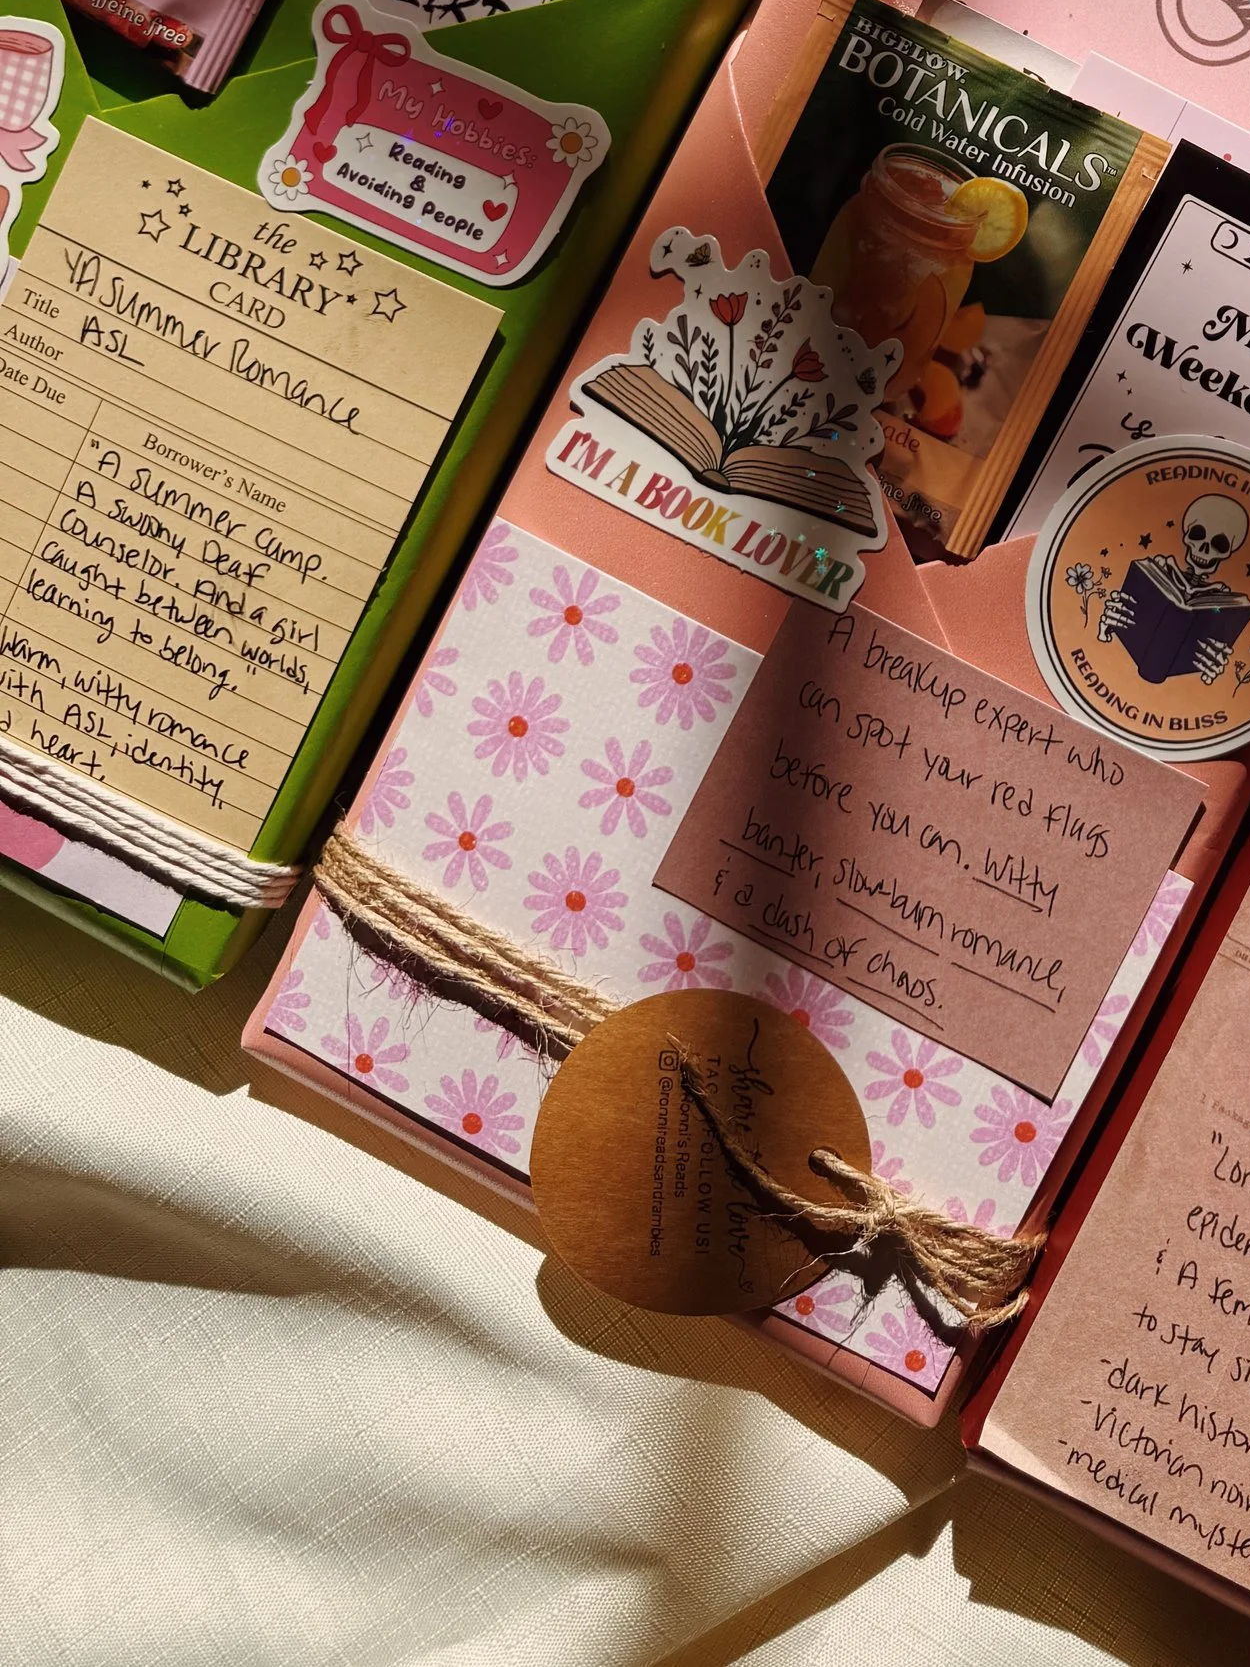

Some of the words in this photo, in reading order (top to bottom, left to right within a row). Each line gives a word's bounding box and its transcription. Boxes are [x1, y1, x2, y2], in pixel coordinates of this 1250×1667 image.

[144, 15, 188, 47] free
[377, 80, 423, 119] My
[432, 105, 538, 169] Hobbies:
[388, 142, 467, 190] Reading
[877, 96, 924, 130] Cold
[931, 118, 990, 162] Water
[992, 153, 1076, 208] Infusion
[336, 162, 416, 209] Avoiding
[421, 201, 484, 241] People
[409, 175, 425, 193] &
[253, 220, 298, 255] the
[64, 248, 100, 296] YA
[179, 224, 340, 317] LIBRARY
[21, 287, 61, 319] Title
[208, 281, 287, 332] CARD
[3, 324, 64, 361] Author
[80, 316, 145, 367] ASL
[31, 376, 66, 404] Due
[142, 432, 235, 489] Borrower's
[236, 477, 287, 514] Name
[1145, 465, 1239, 487] READING
[75, 481, 96, 509] A
[202, 540, 271, 587] Deaf
[556, 429, 616, 481] I'M
[608, 460, 641, 497] A
[634, 471, 742, 546] BOOK
[730, 520, 854, 601] LOVER
[40, 541, 126, 600] caught
[138, 580, 233, 644] between
[827, 615, 856, 653] A
[864, 630, 968, 718] breakup
[974, 696, 1064, 755] expert
[1067, 745, 1125, 787] who
[1071, 648, 1139, 721] READING
[1143, 711, 1164, 729] IN
[1168, 710, 1228, 731] BLISS
